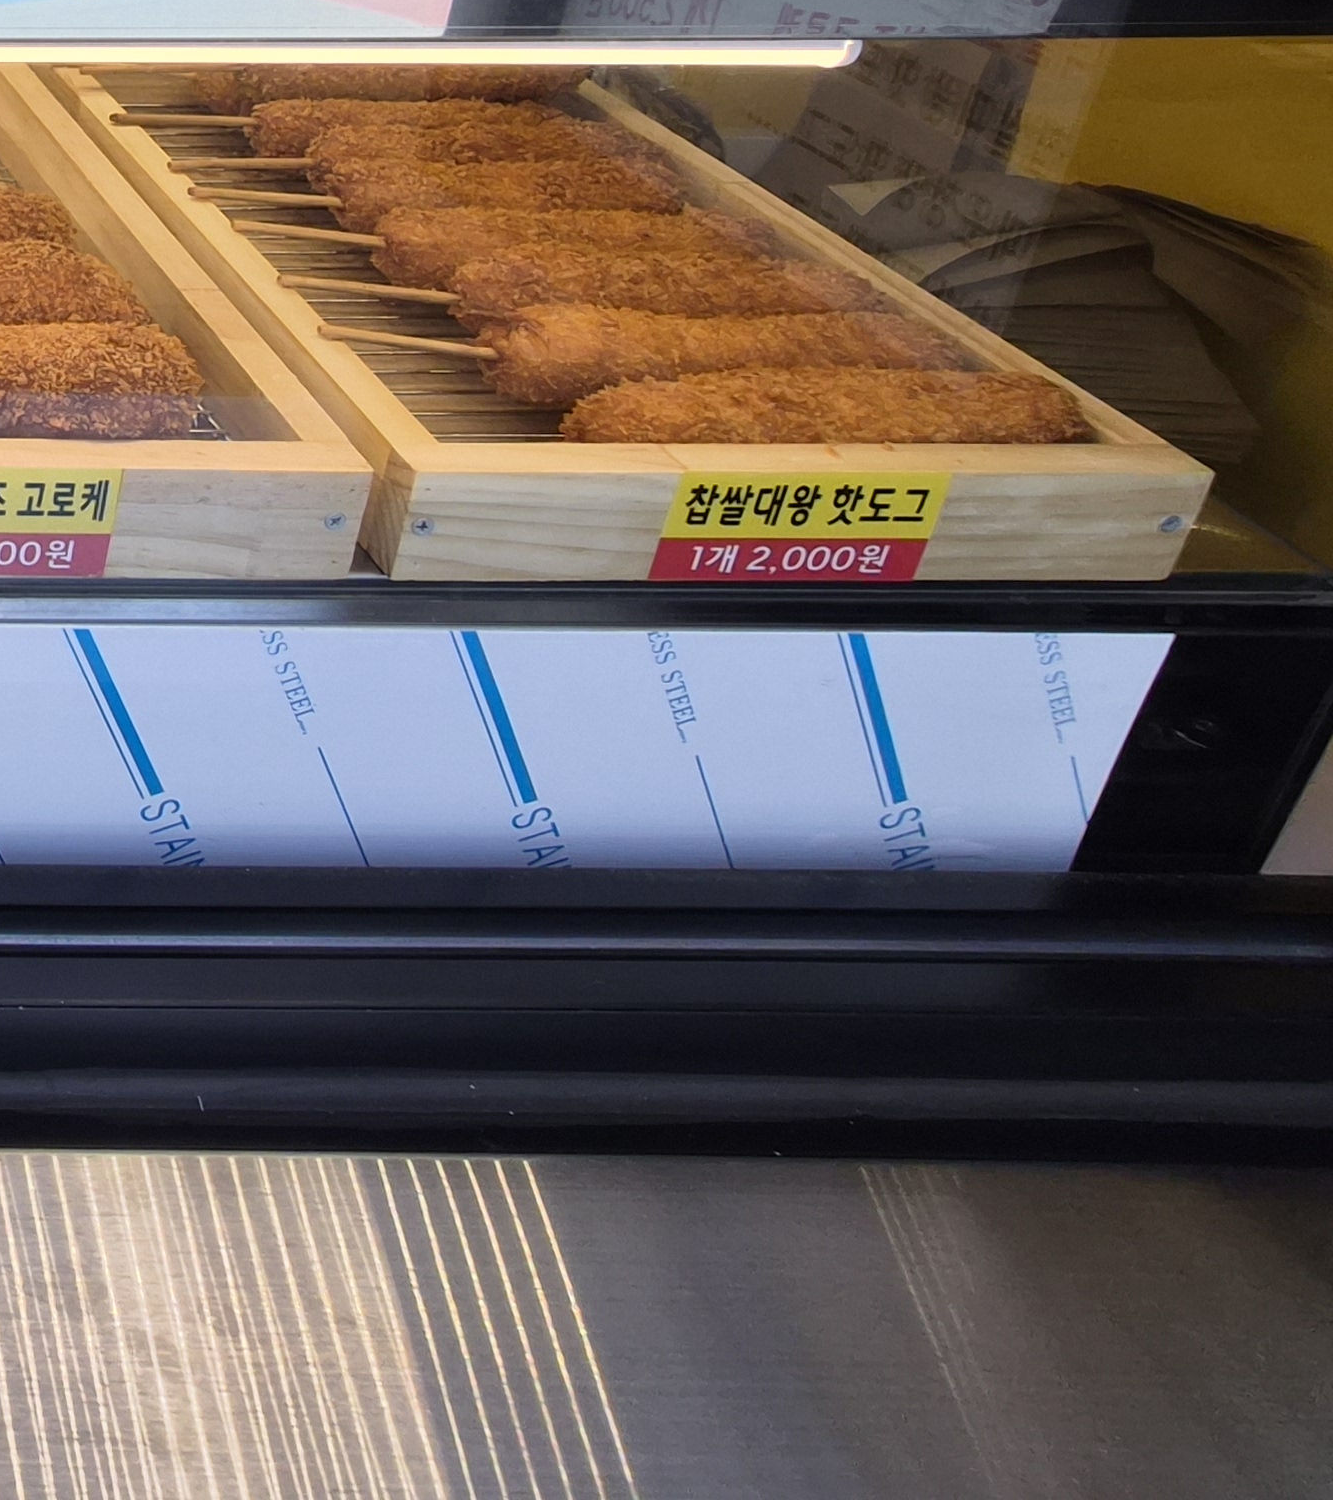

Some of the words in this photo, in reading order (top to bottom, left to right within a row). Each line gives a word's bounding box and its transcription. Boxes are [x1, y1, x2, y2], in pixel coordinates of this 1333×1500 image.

[16, 479, 110, 522] 고로케
[685, 484, 822, 527] 찹쌀대왕
[827, 484, 930, 526] 핫도그
[690, 544, 739, 574] 1개
[746, 544, 891, 575] 2,000원
[274, 661, 316, 725] STEEL
[661, 669, 697, 734] STEEL
[1044, 669, 1077, 735] STEEL
